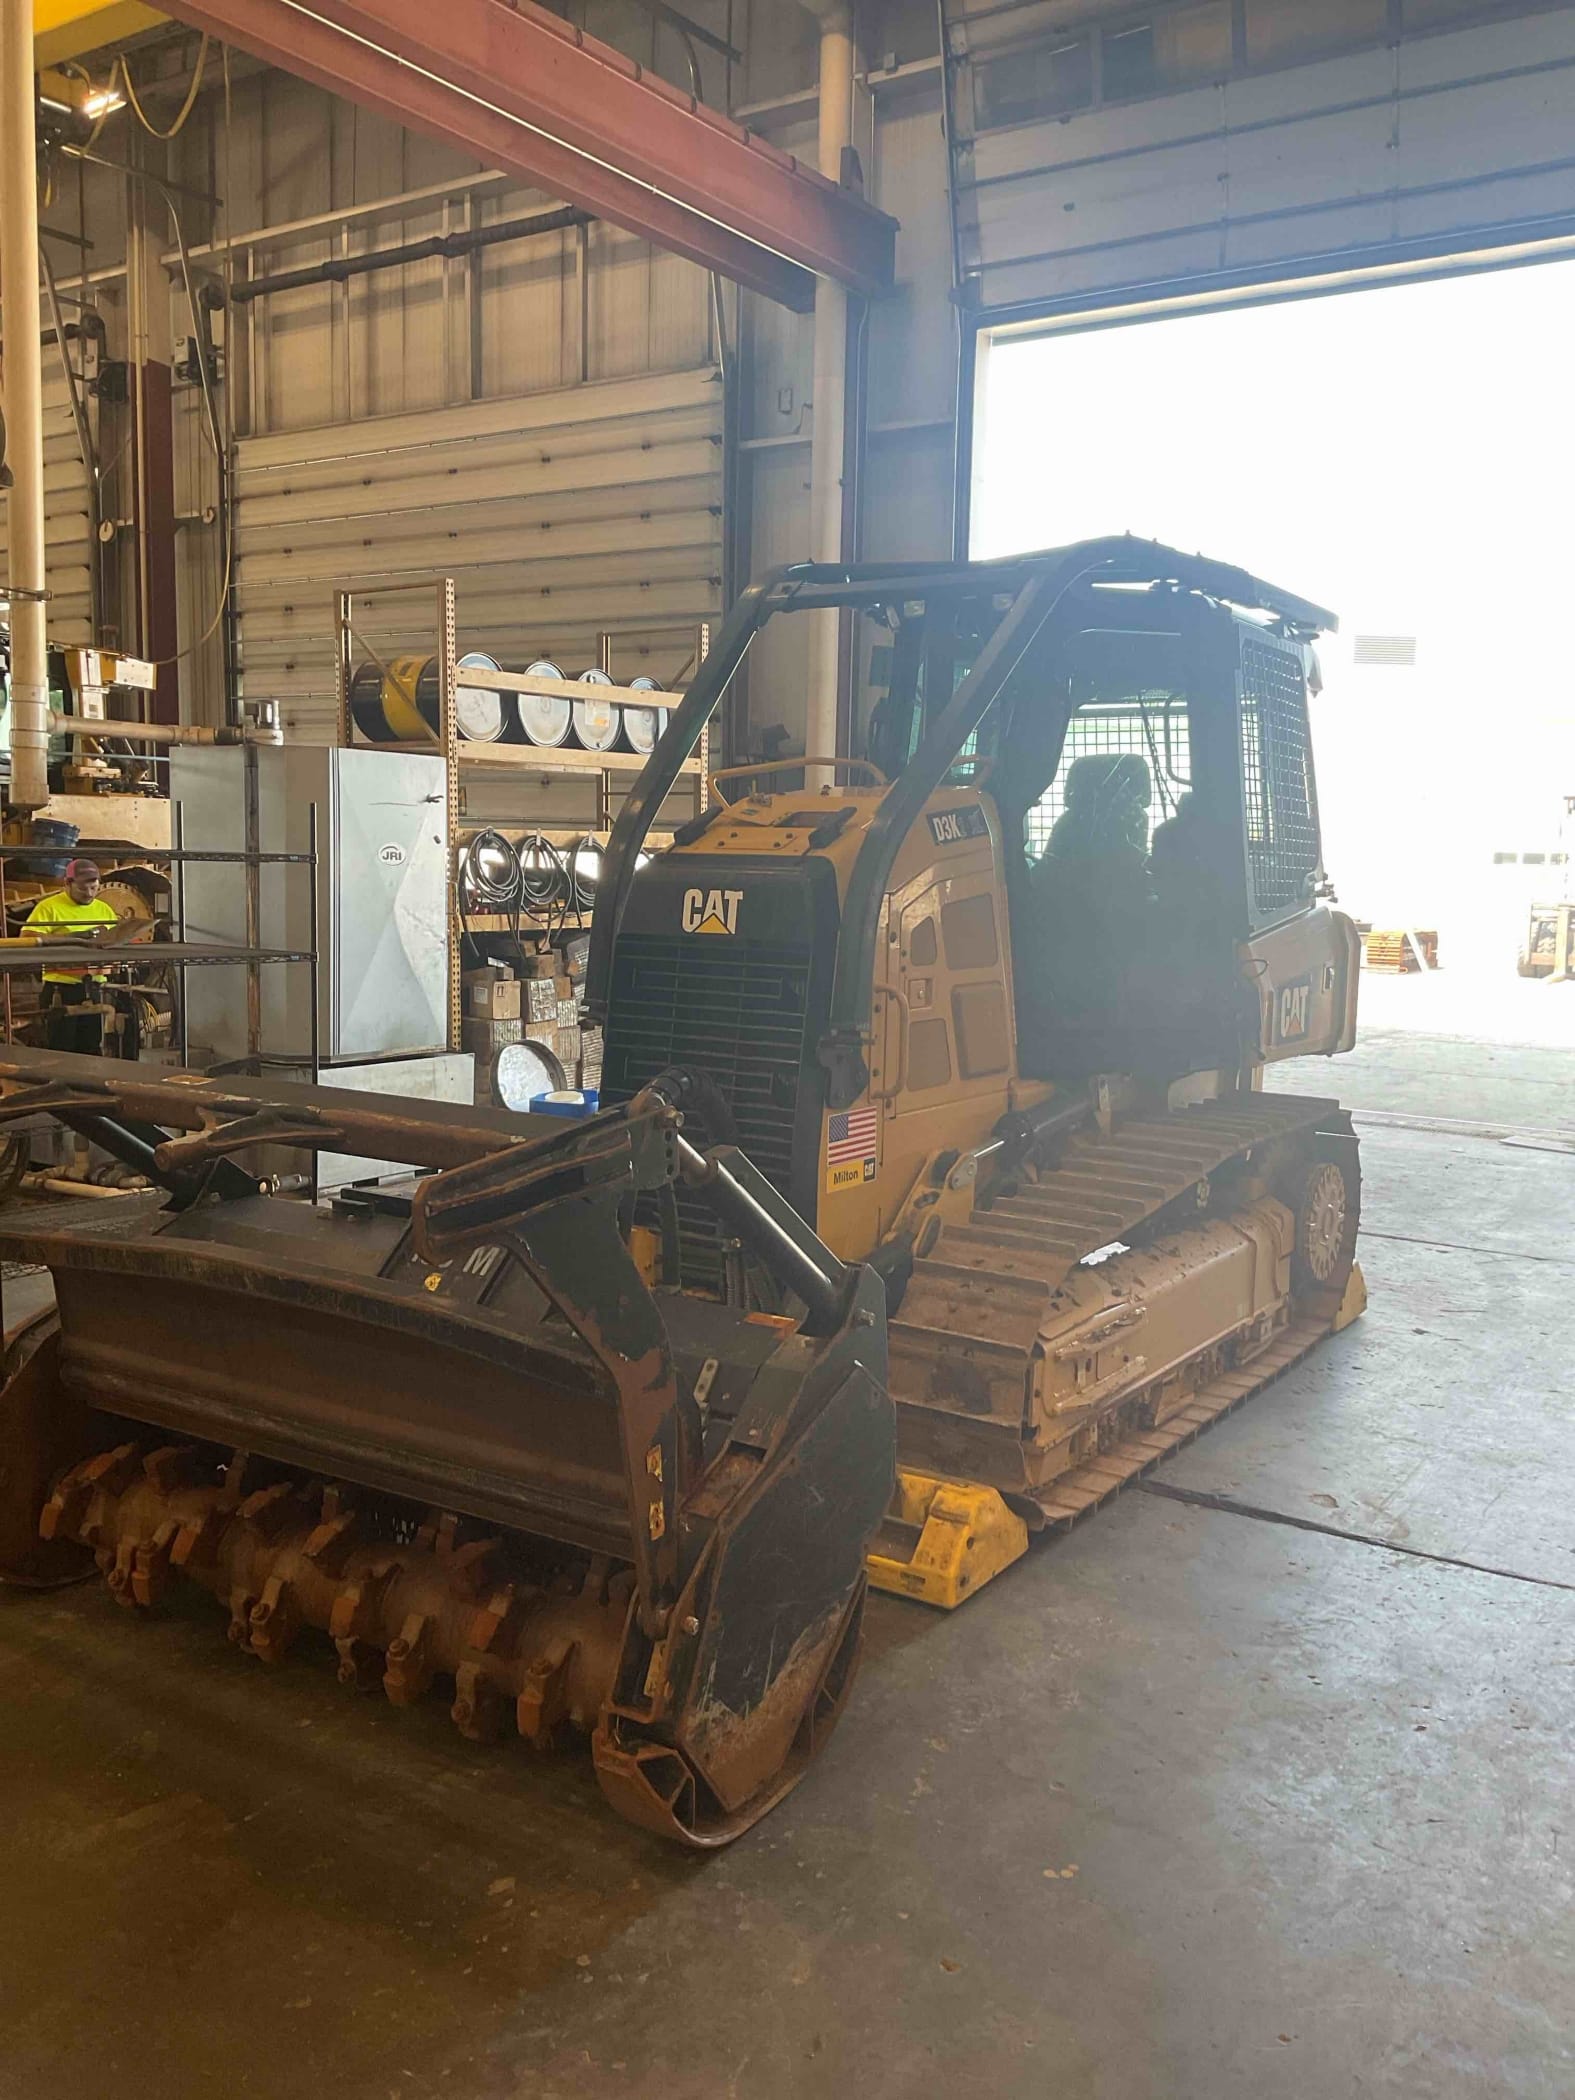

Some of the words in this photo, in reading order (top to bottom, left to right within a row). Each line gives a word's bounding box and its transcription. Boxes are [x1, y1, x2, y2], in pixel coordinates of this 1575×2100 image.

[382, 851, 402, 861] JRI
[682, 888, 744, 935] CAT
[1281, 985, 1309, 1038] CAT
[833, 1170, 859, 1185] Milton
